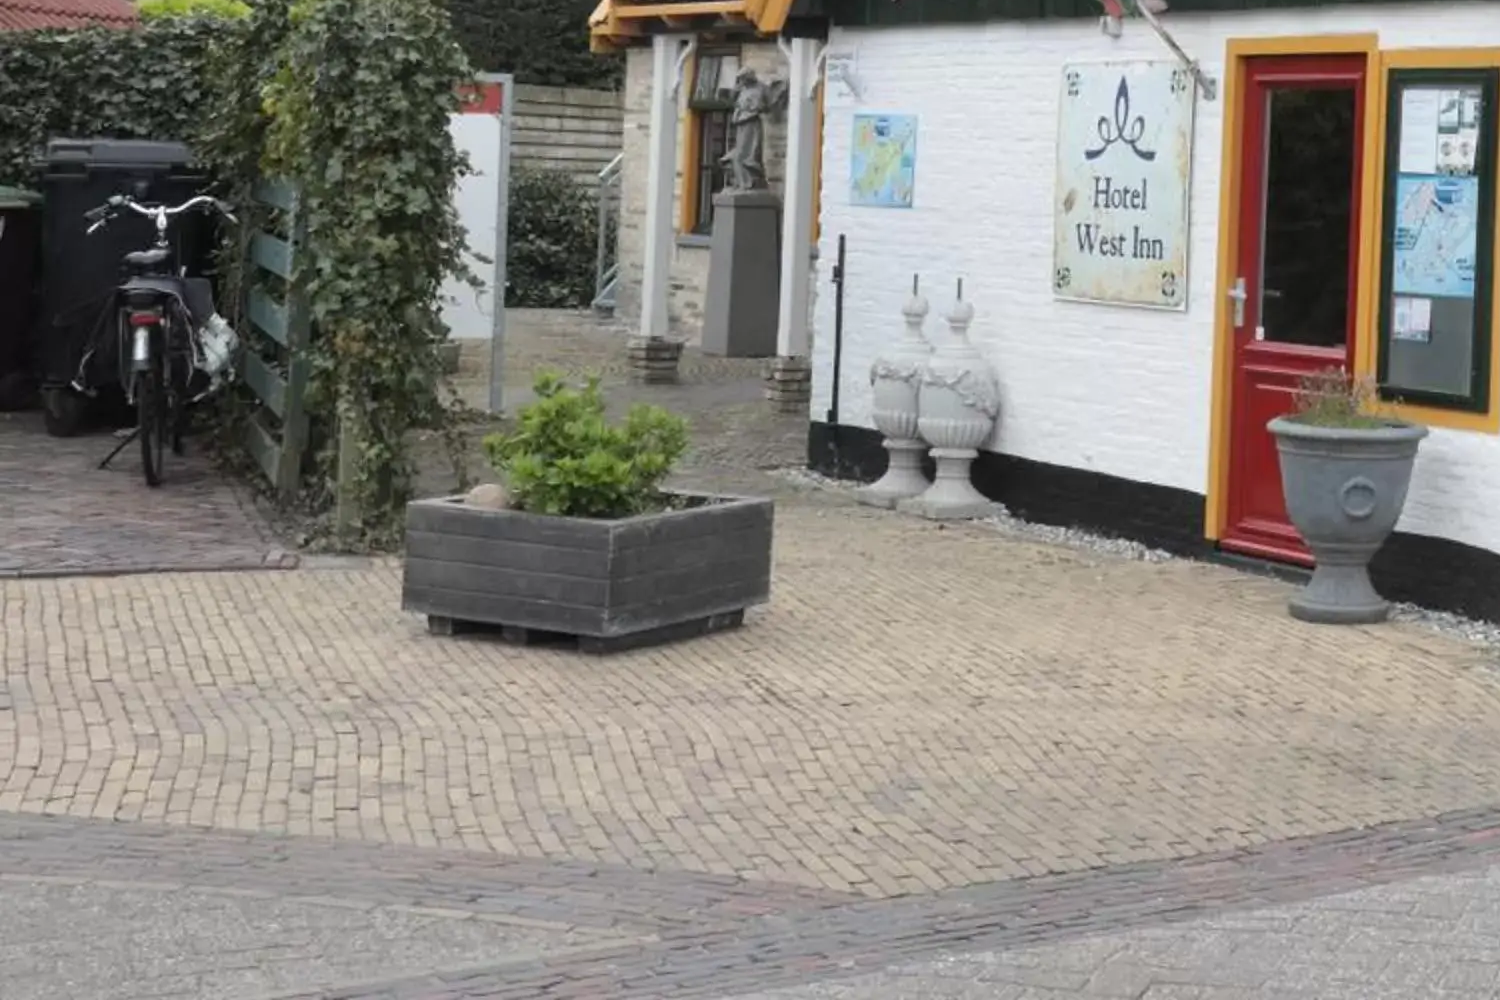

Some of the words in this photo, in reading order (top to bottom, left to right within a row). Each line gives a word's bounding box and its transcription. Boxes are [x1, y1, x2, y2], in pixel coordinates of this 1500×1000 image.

[1093, 175, 1147, 211] Hotel
[1076, 222, 1126, 258] West
[1132, 223, 1164, 260] Inn
